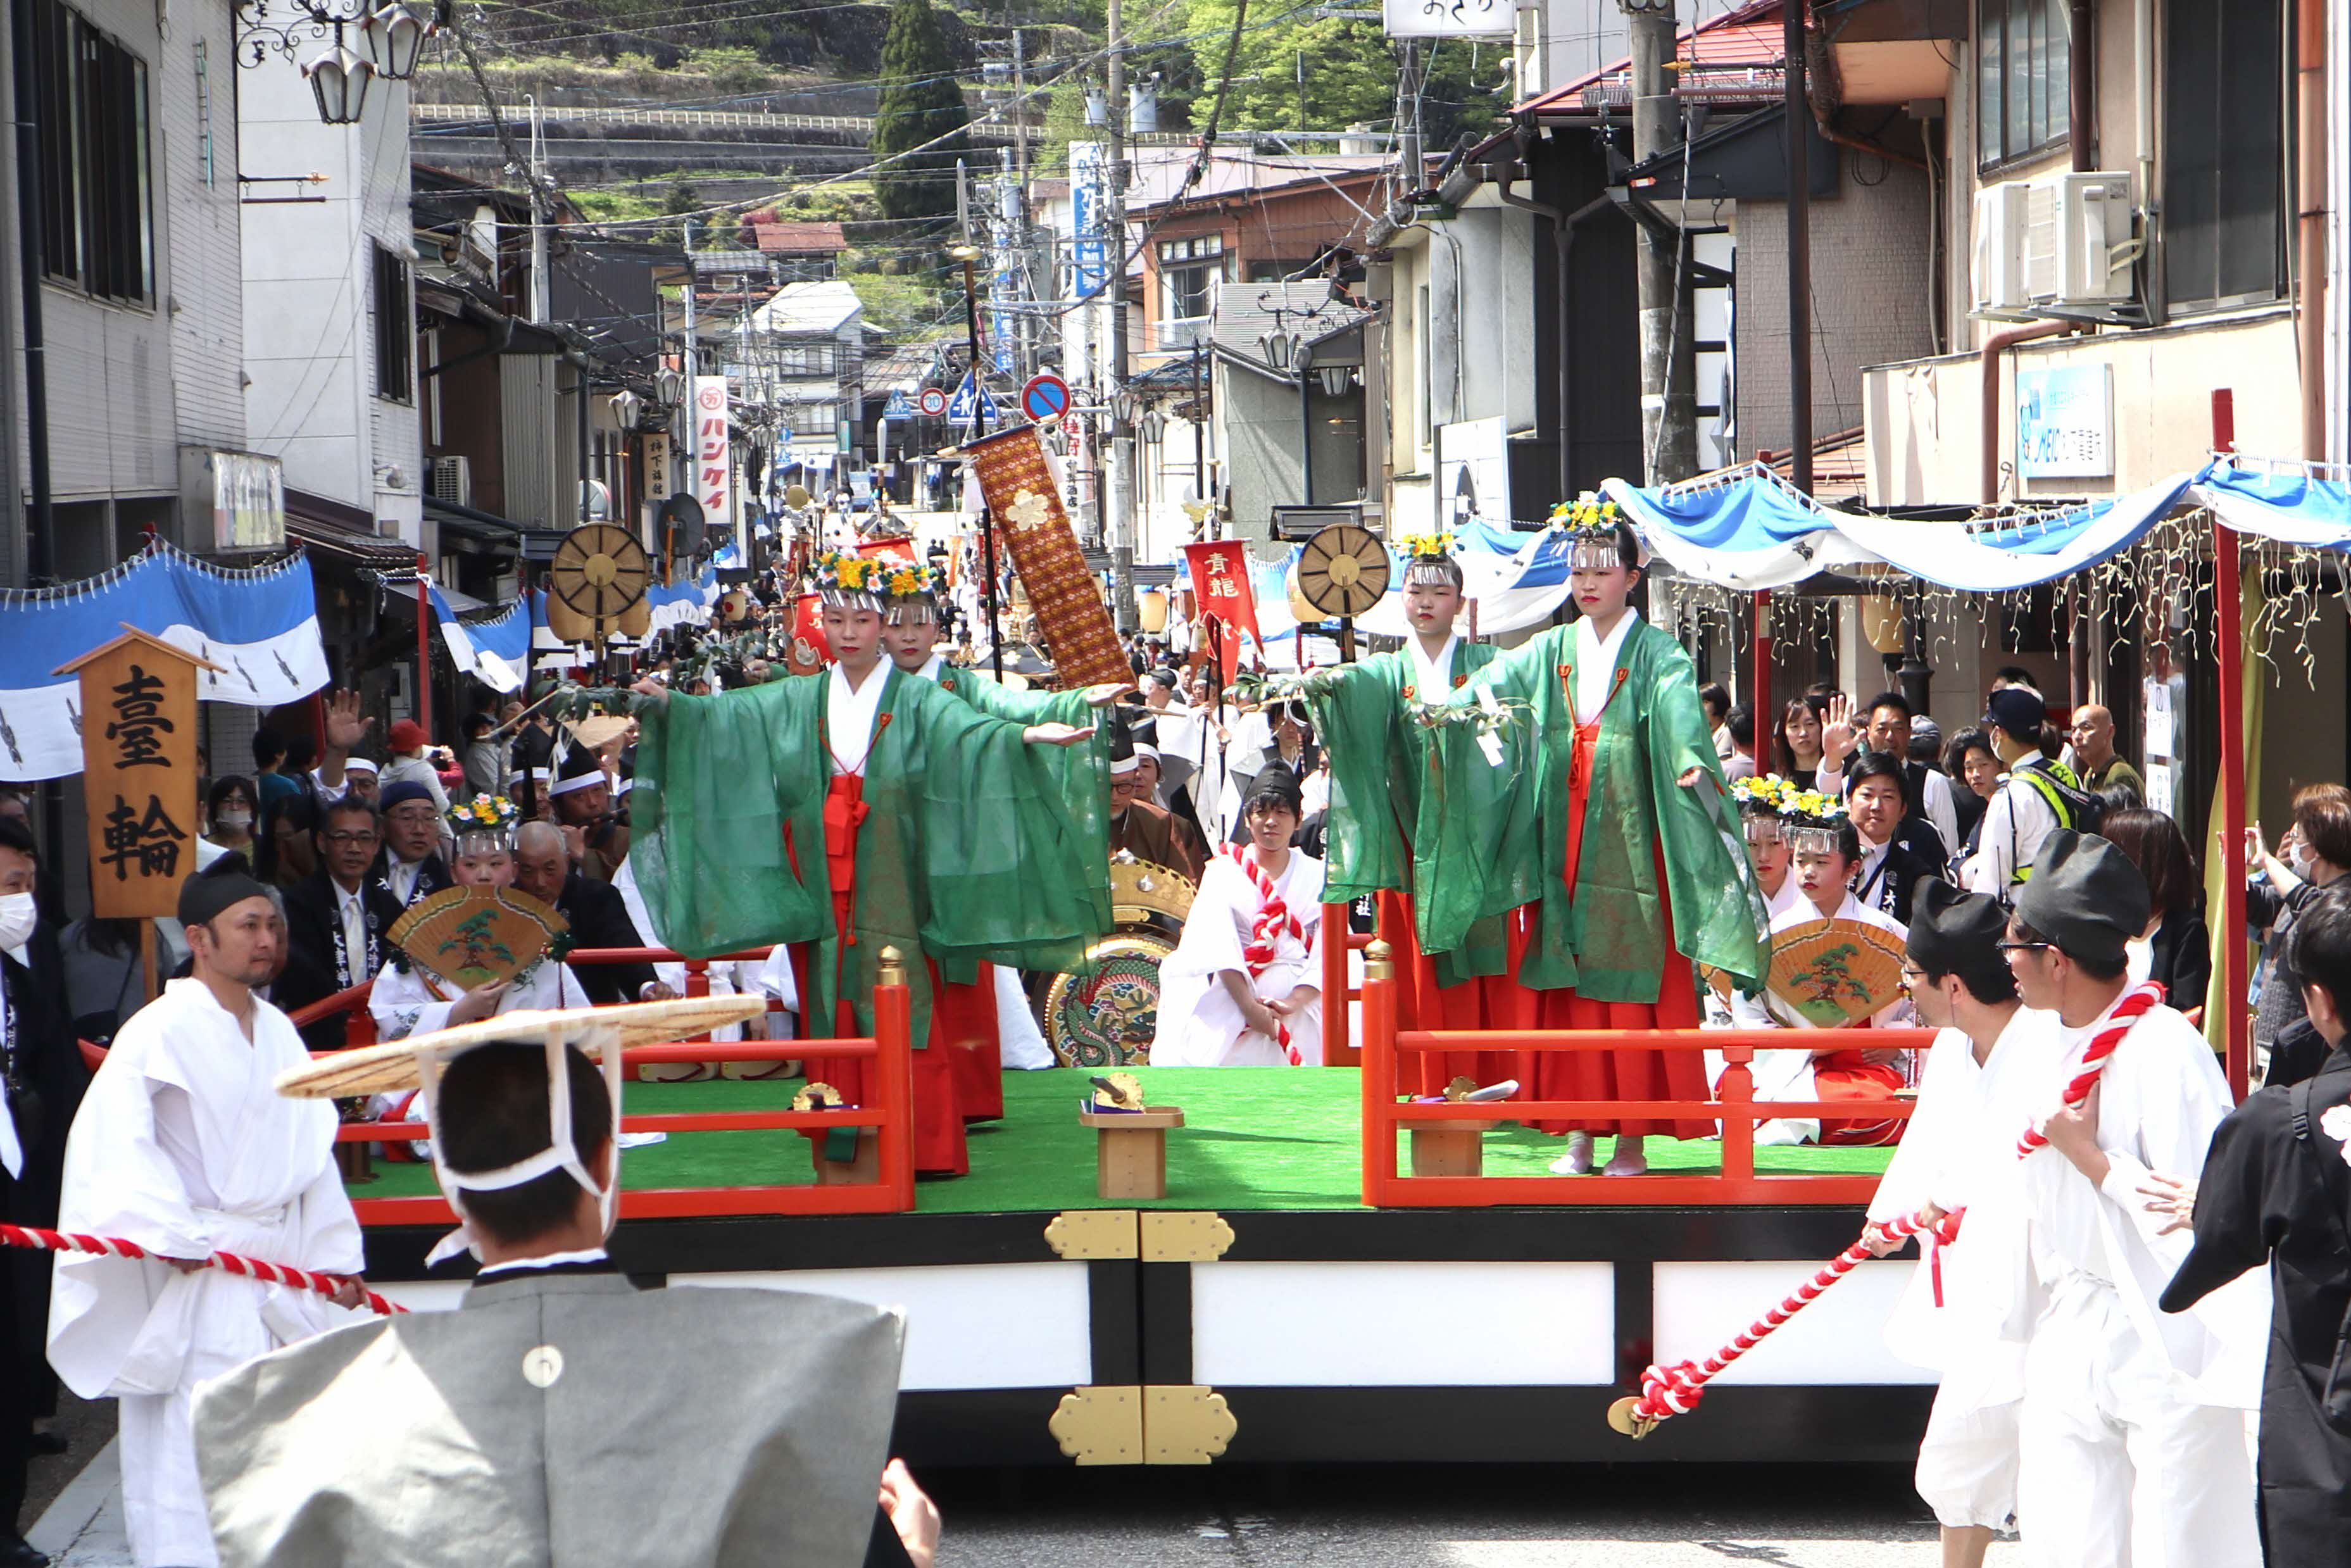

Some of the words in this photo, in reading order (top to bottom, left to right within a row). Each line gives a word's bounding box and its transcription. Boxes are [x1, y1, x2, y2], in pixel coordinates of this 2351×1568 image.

[925, 396, 940, 408] 30
[701, 418, 726, 508] パンケイ
[1204, 552, 1239, 598] 青龍
[99, 665, 188, 881] 臺輪
[332, 931, 351, 991] 大津神
